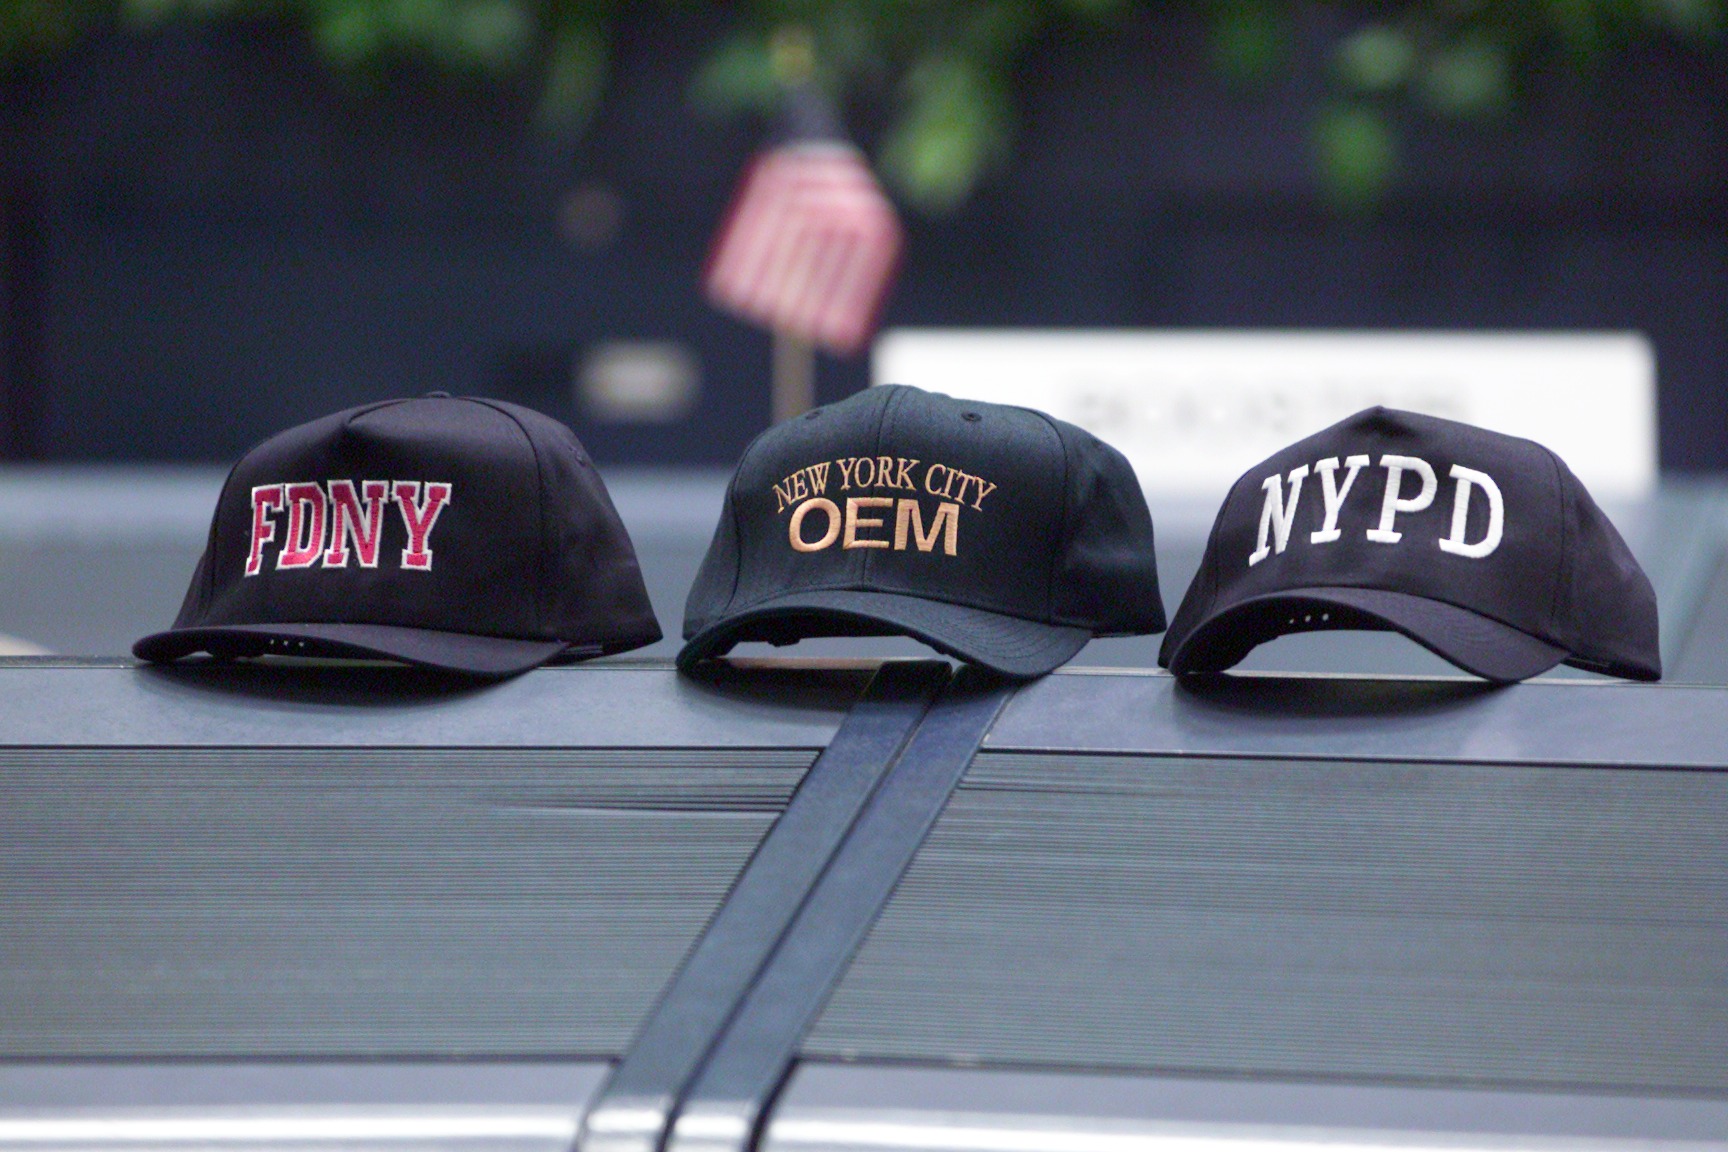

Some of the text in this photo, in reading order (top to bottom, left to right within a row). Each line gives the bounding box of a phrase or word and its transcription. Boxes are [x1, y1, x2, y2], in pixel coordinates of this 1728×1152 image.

[772, 455, 998, 513] NEW YORK CITY
[1248, 454, 1505, 567] NYPD
[244, 479, 453, 577] FDNY
[789, 496, 960, 556] OEM
